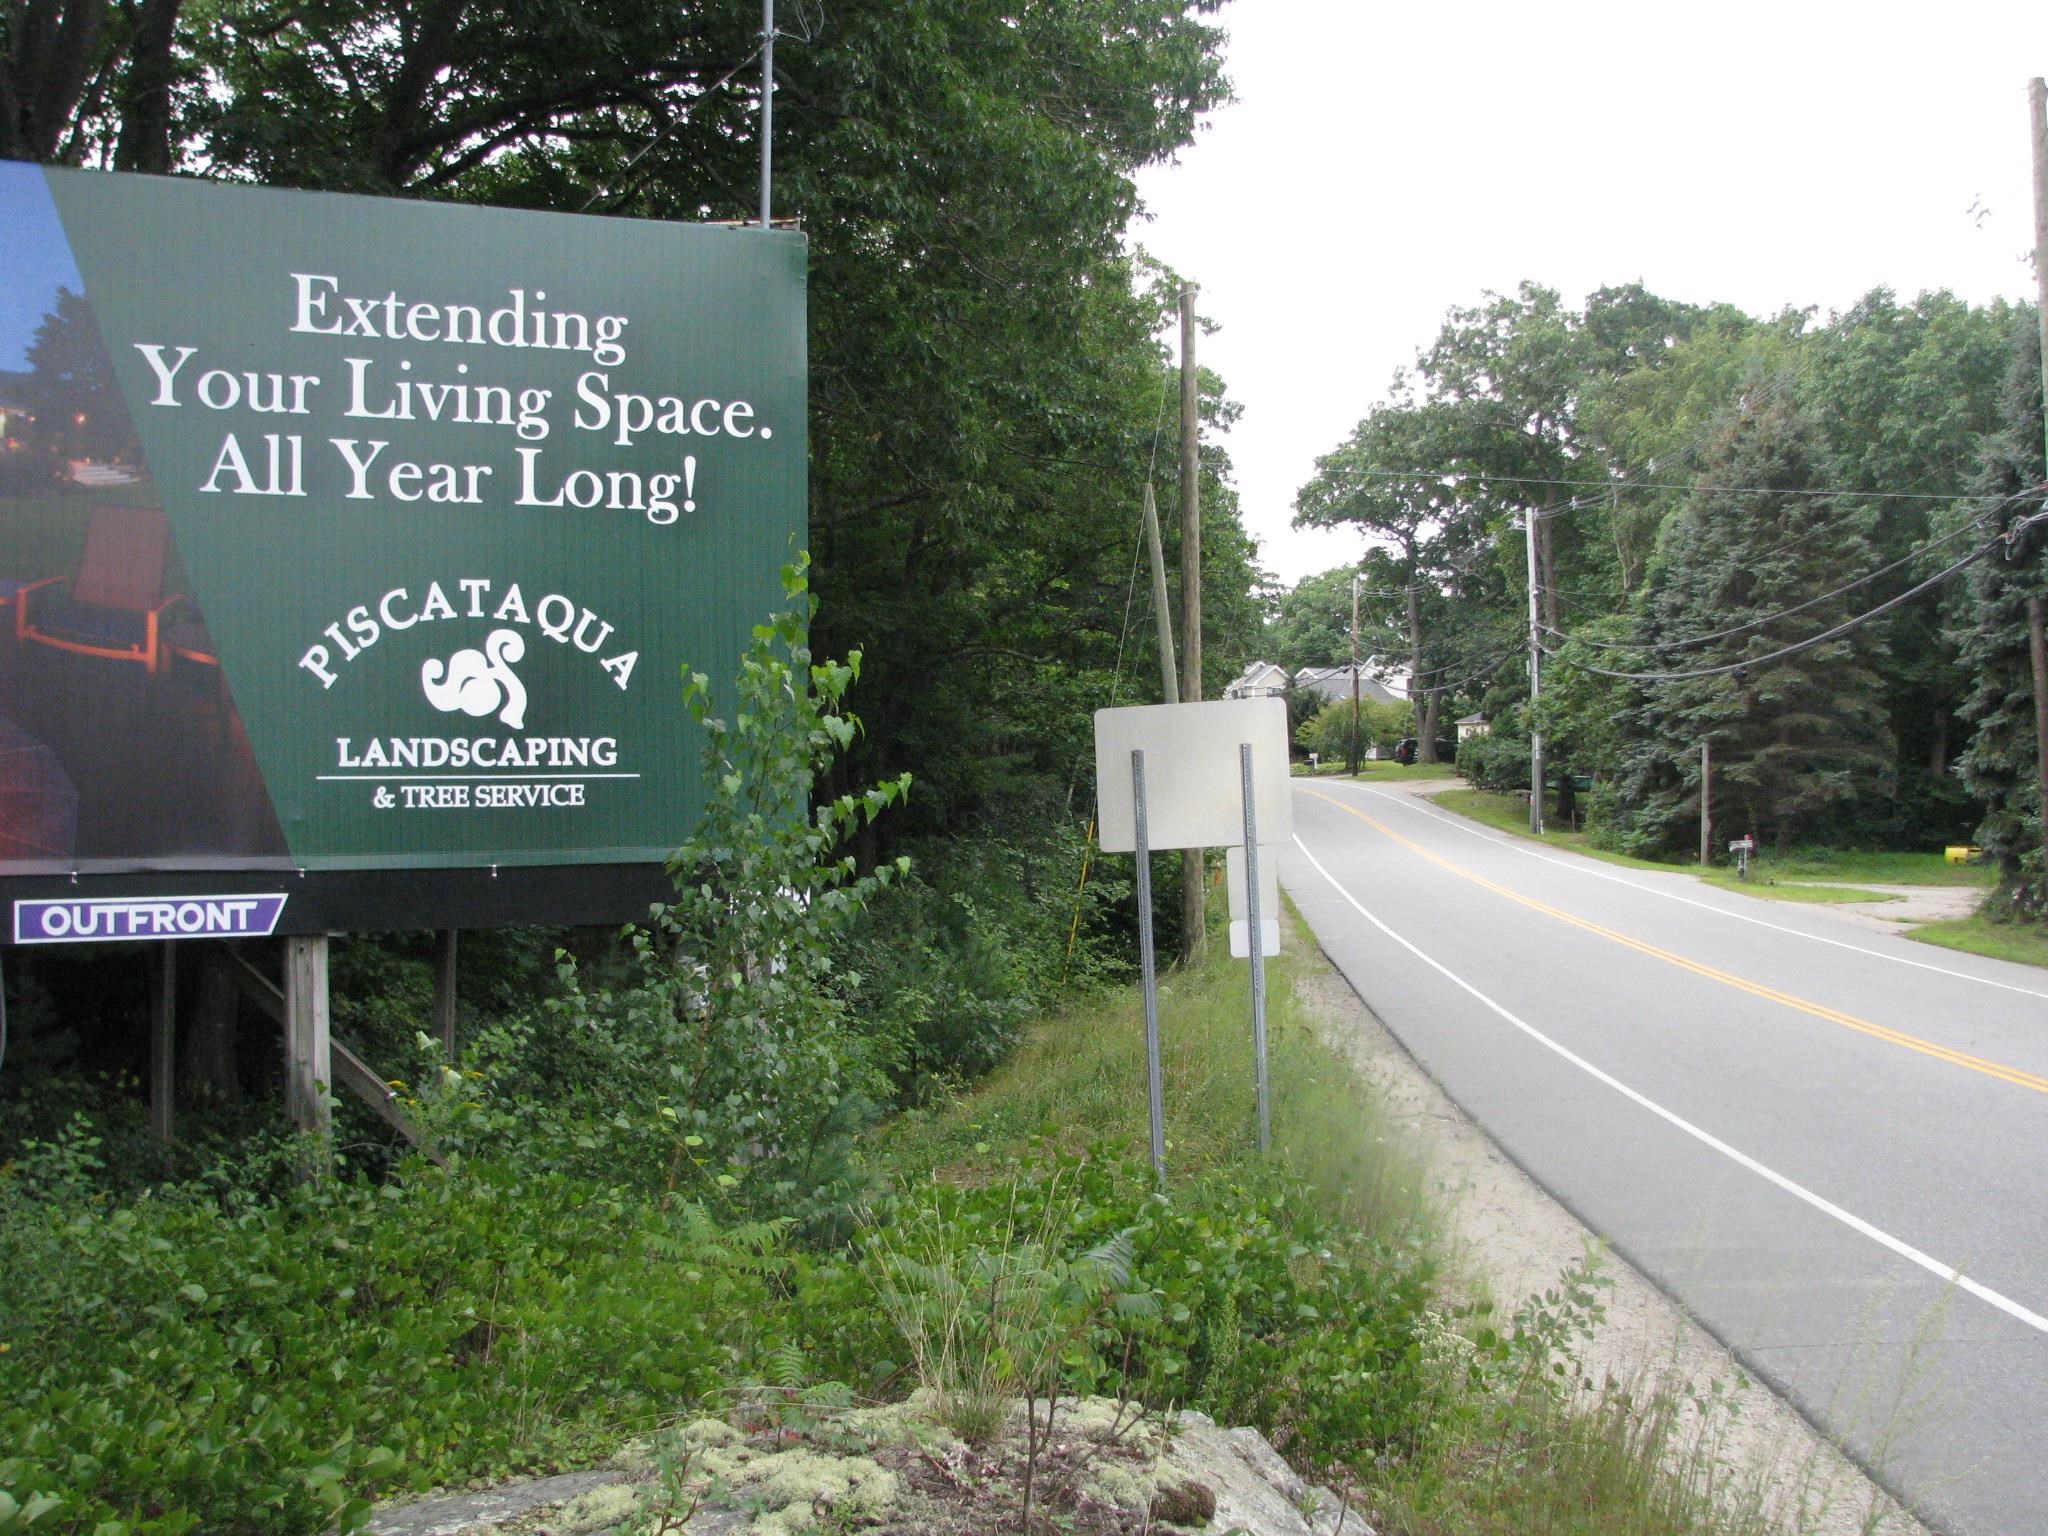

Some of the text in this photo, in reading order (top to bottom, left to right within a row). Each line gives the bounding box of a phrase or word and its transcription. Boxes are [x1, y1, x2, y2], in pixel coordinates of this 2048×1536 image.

[289, 272, 630, 366] Extending
[133, 343, 774, 446] Your Living Space.
[199, 433, 697, 525] All Year Long!
[298, 578, 640, 692] PISCATAQUA
[336, 737, 618, 768] LANDSCAPING
[373, 784, 585, 809] & TREE SERVICE
[41, 901, 258, 936] OUTFRONT
